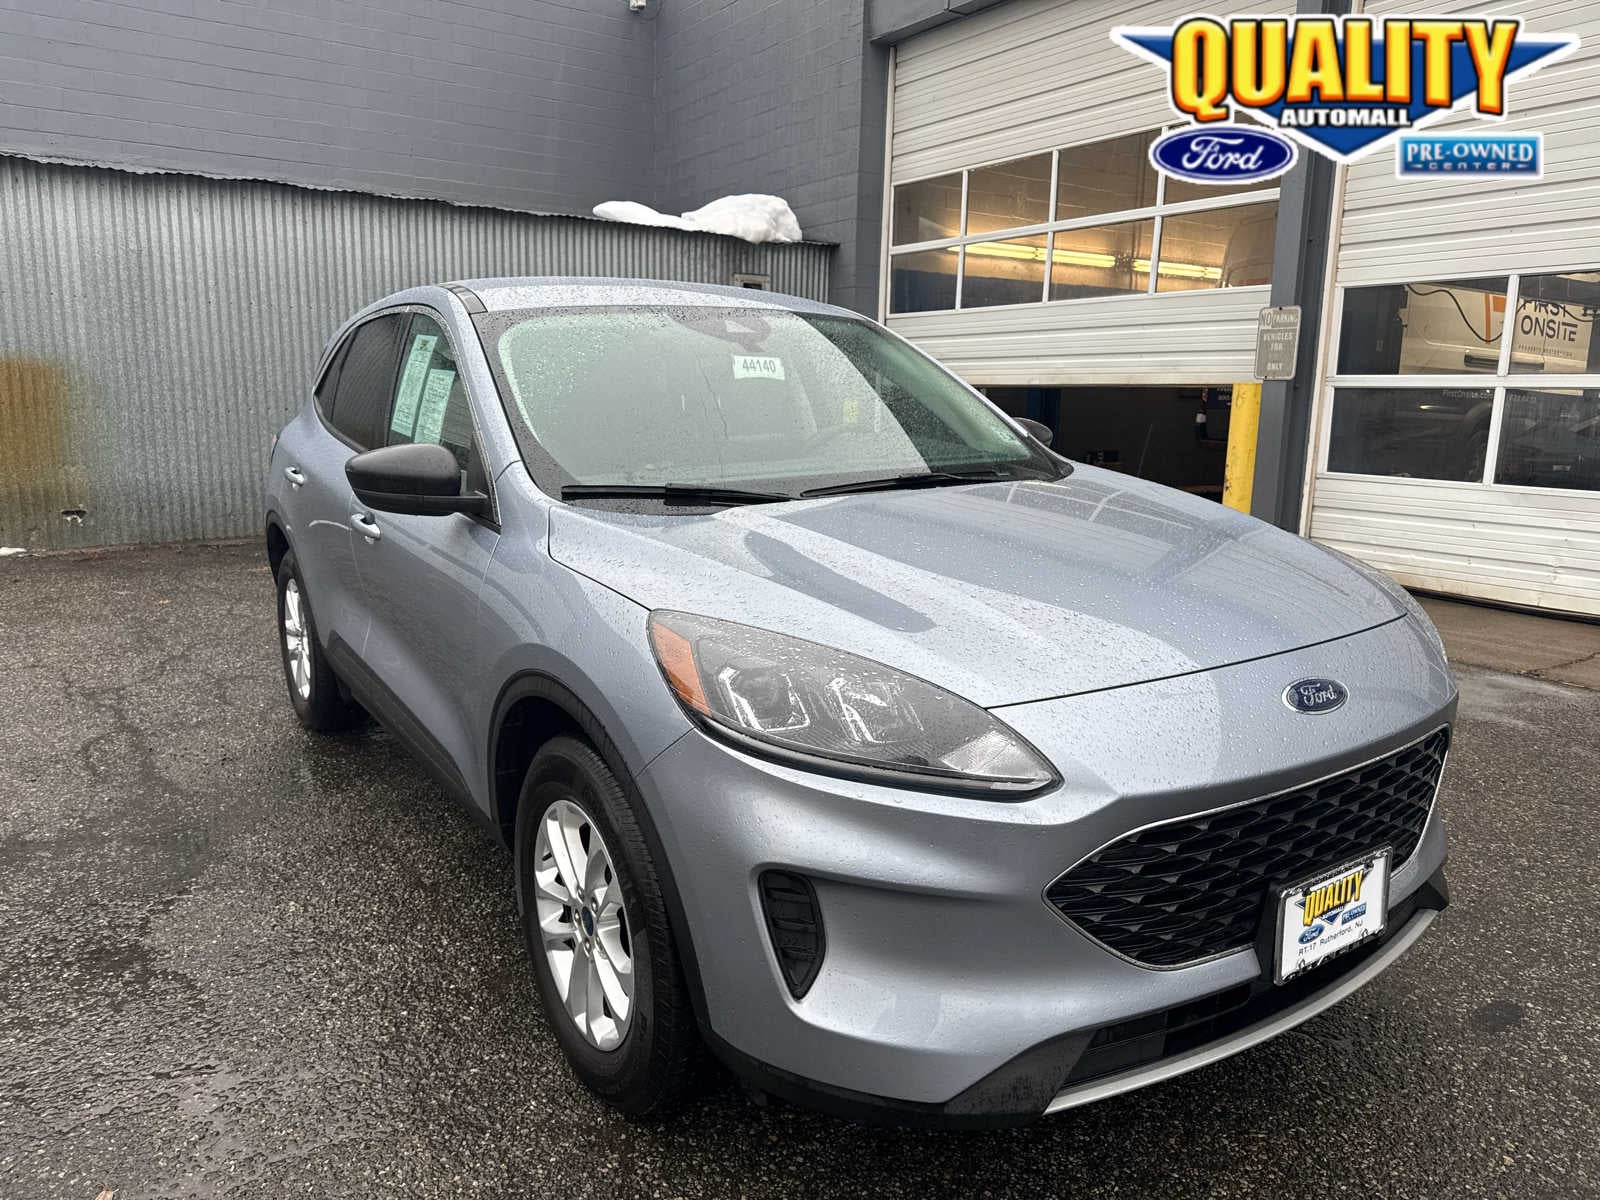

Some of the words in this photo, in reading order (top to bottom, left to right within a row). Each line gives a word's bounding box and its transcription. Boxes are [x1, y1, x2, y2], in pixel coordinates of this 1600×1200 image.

[1261, 310, 1272, 327] NO
[1273, 313, 1299, 323] PARKING
[1263, 331, 1293, 341] VEHICLES
[1521, 315, 1578, 342] ONSITE
[742, 359, 777, 373] 44140
[1267, 362, 1283, 371] ONLY
[1300, 683, 1337, 706] Ford
[1303, 870, 1365, 926] QUALITY
[1354, 919, 1364, 928] NJ
